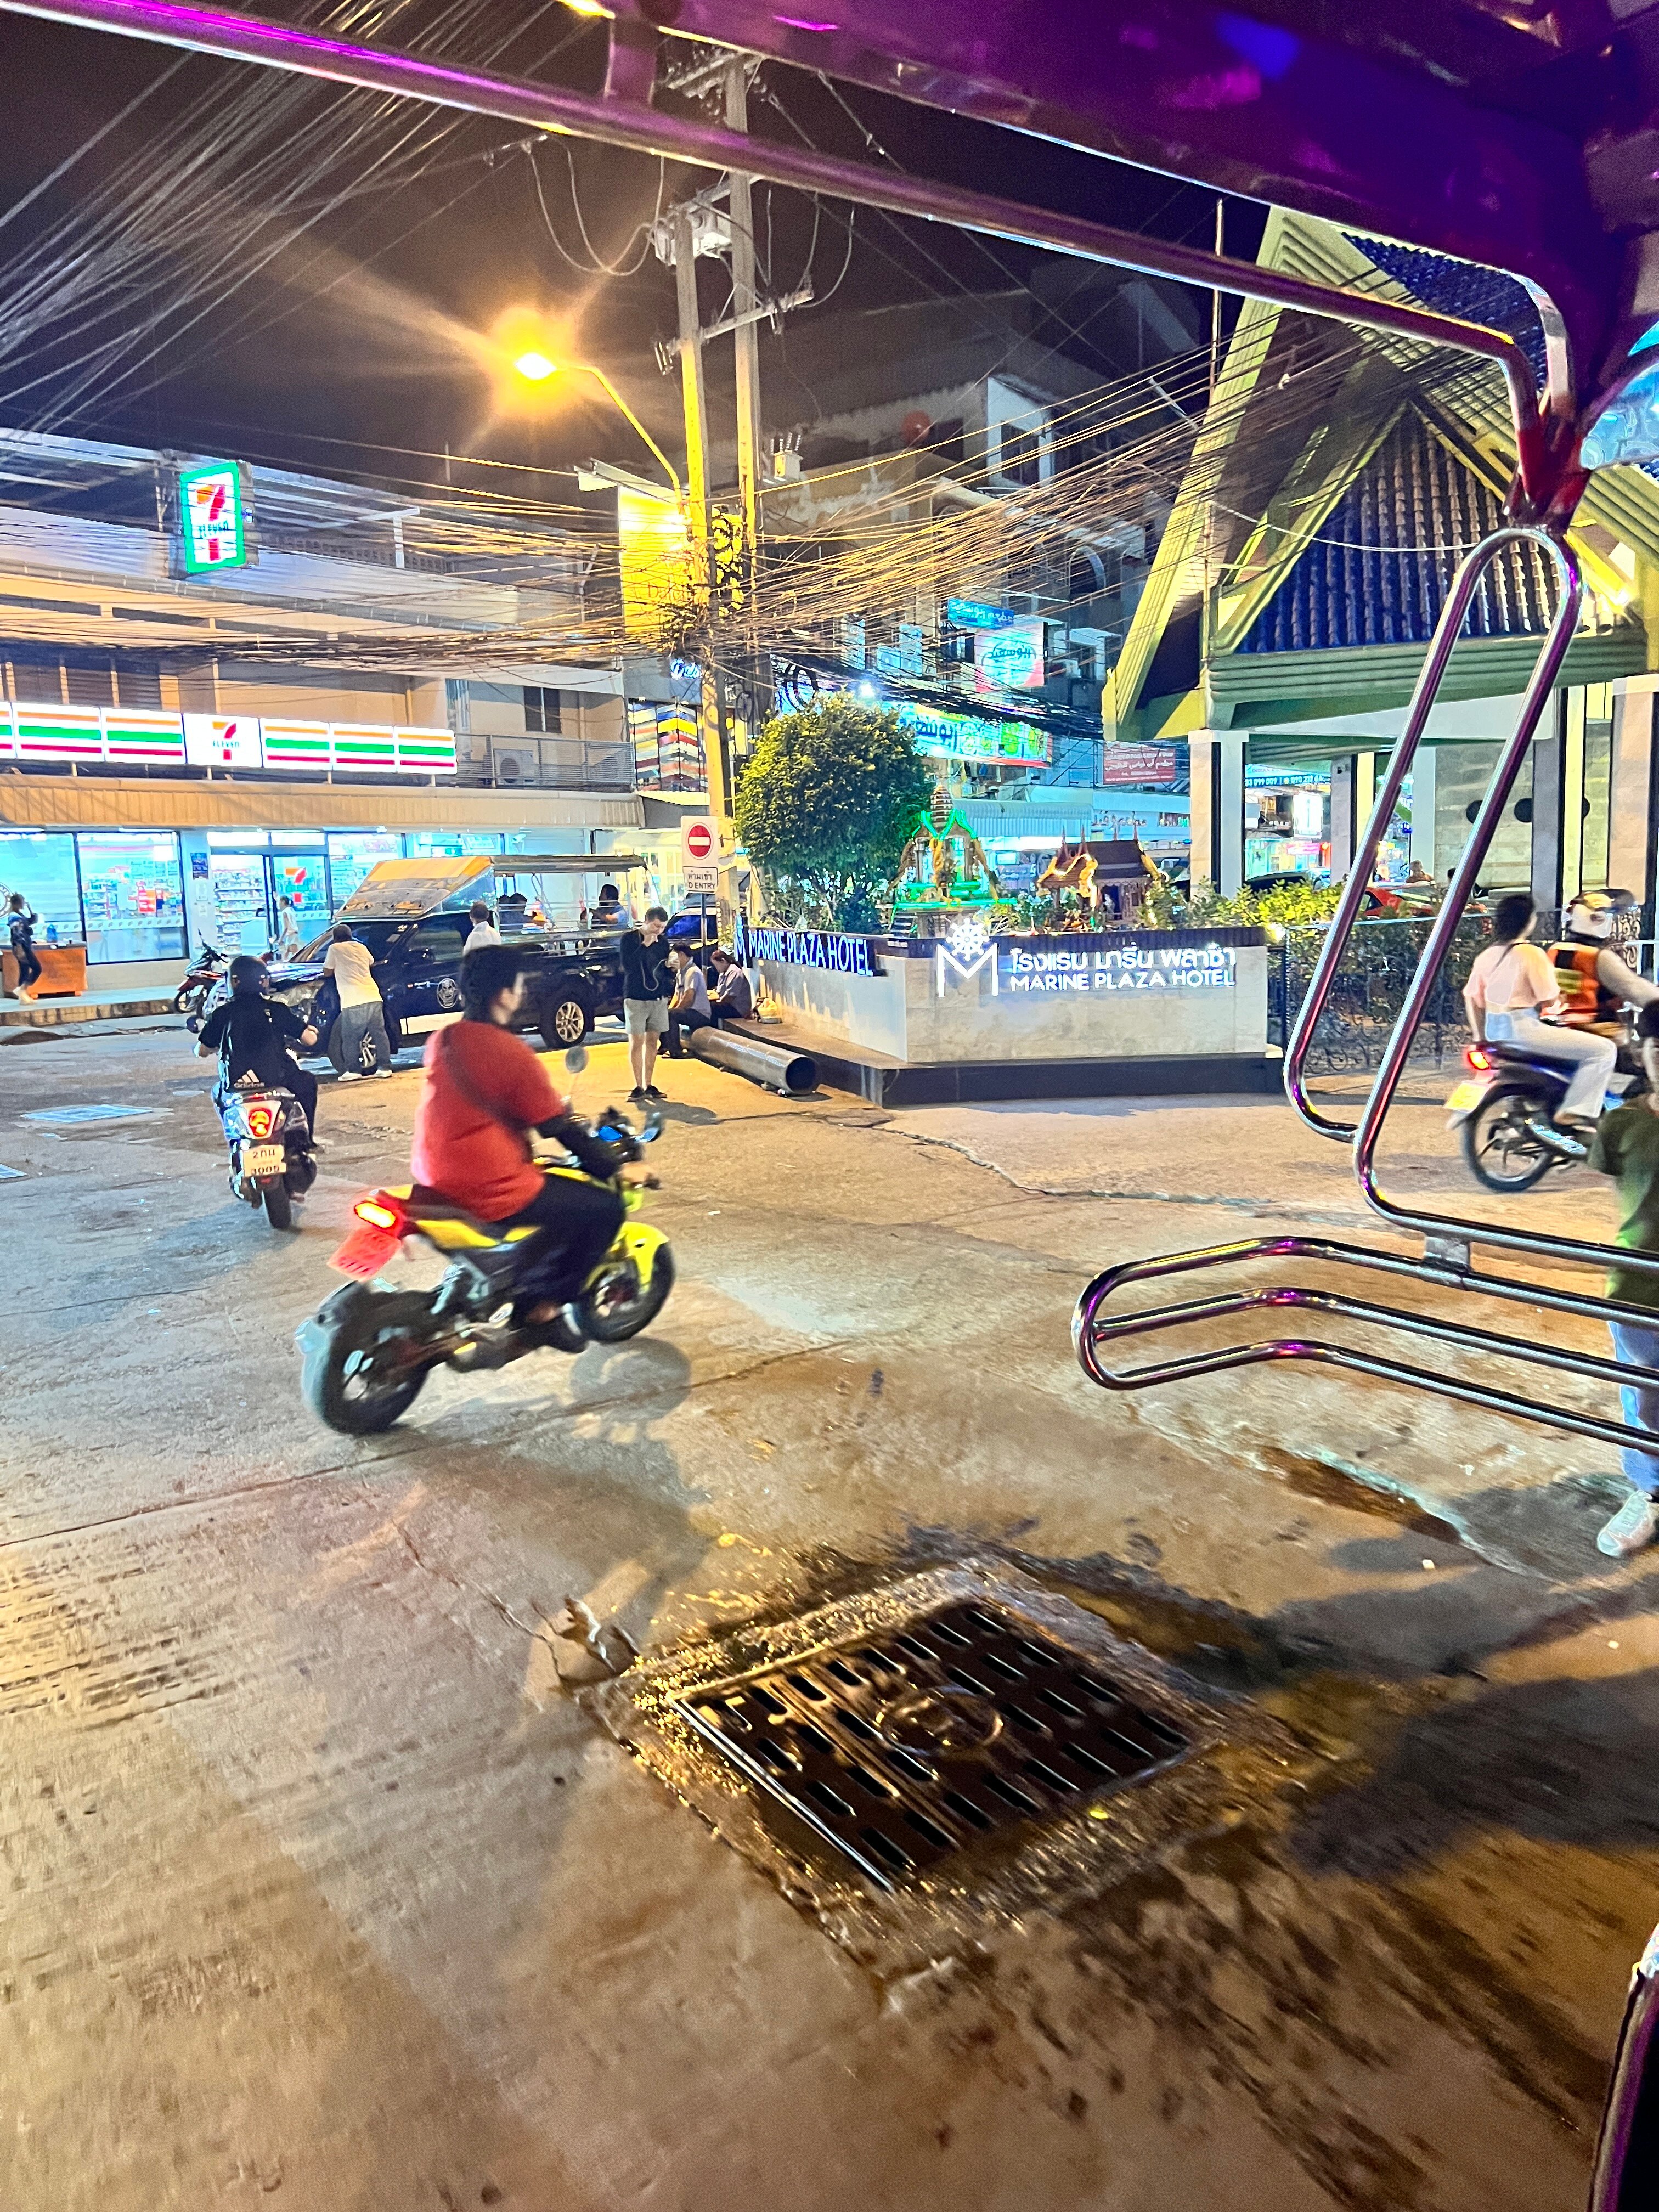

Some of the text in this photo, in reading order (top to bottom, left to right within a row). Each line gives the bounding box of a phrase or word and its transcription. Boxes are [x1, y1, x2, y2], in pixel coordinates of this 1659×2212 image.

[748, 930, 873, 977] MARINE PLAZA HOTEL
[1010, 948, 1088, 974] โรงแรม
[1011, 969, 1235, 992] MARINE PLAZA HOTEL
